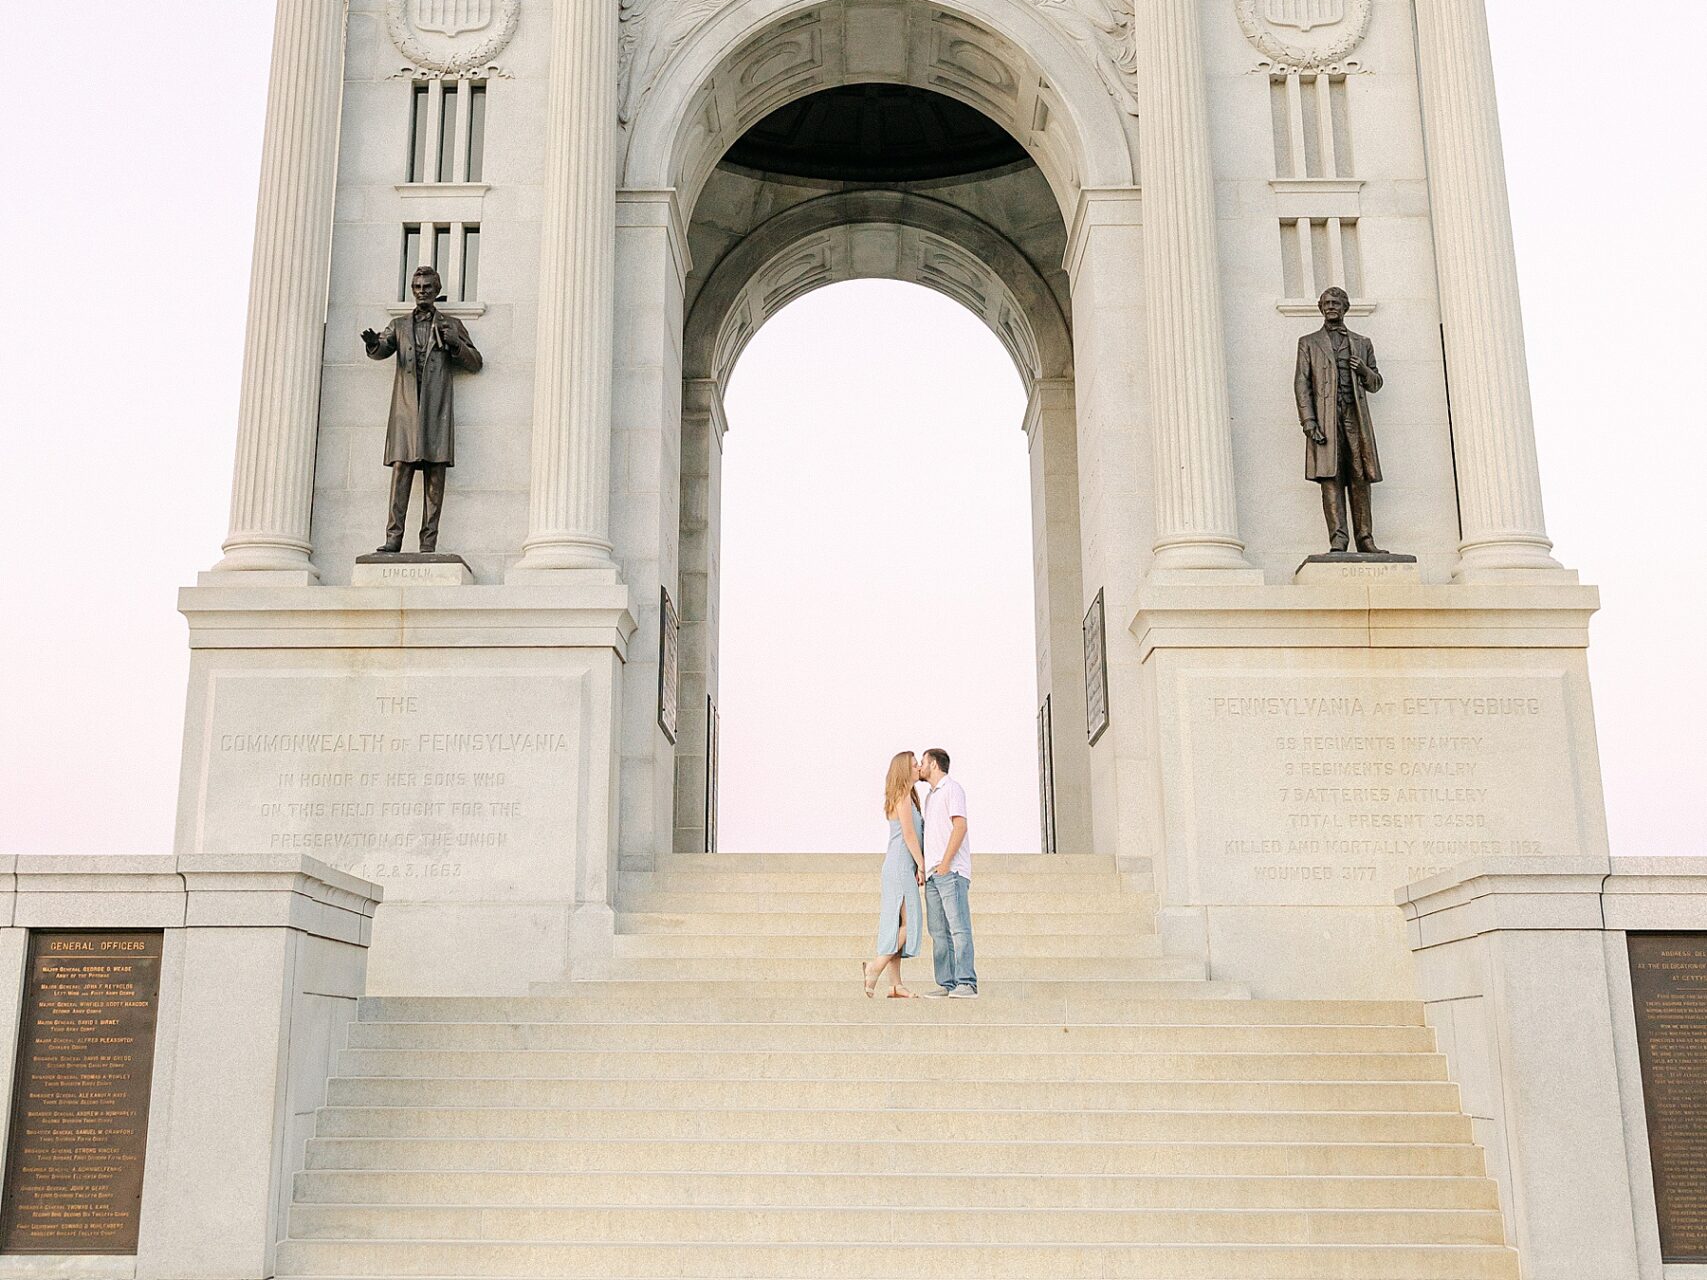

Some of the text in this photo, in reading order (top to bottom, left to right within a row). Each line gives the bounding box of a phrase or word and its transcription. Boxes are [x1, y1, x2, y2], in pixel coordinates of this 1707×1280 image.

[383, 569, 432, 577] LINCOLN
[1342, 568, 1384, 577] CURTIN
[377, 697, 418, 713] THE
[1211, 698, 1541, 716] PENNSYLVANIA AT GETTYSBURG
[220, 734, 568, 752] COMMONWEALTH OF PENNSYLVANIA
[1275, 737, 1483, 751] 69 REGIMENTS INFANTRY
[1301, 762, 1394, 776] REGIMENTS
[1399, 762, 1477, 776] CAVALRY
[279, 773, 506, 787] IN HONOR OF HER SONS WHO
[1279, 788, 1489, 802] 7 BATTERIES ARTILLERY
[261, 803, 521, 817] ON THIS FIELD FOUGHT FOR THE
[1288, 814, 1343, 829] TOTAL
[1349, 814, 1425, 829] PRESENT
[270, 833, 508, 848] PRESERVATION OF THE UNION
[1224, 841, 1281, 855] KILLED
[1287, 841, 1320, 855] AND
[1326, 841, 1414, 855] MORTALLY
[1422, 841, 1500, 855] WOUNDED
[424, 864, 461, 876] 1863
[1254, 867, 1332, 881] WOUNDED
[51, 942, 145, 950] GENERAL OFFICERS
